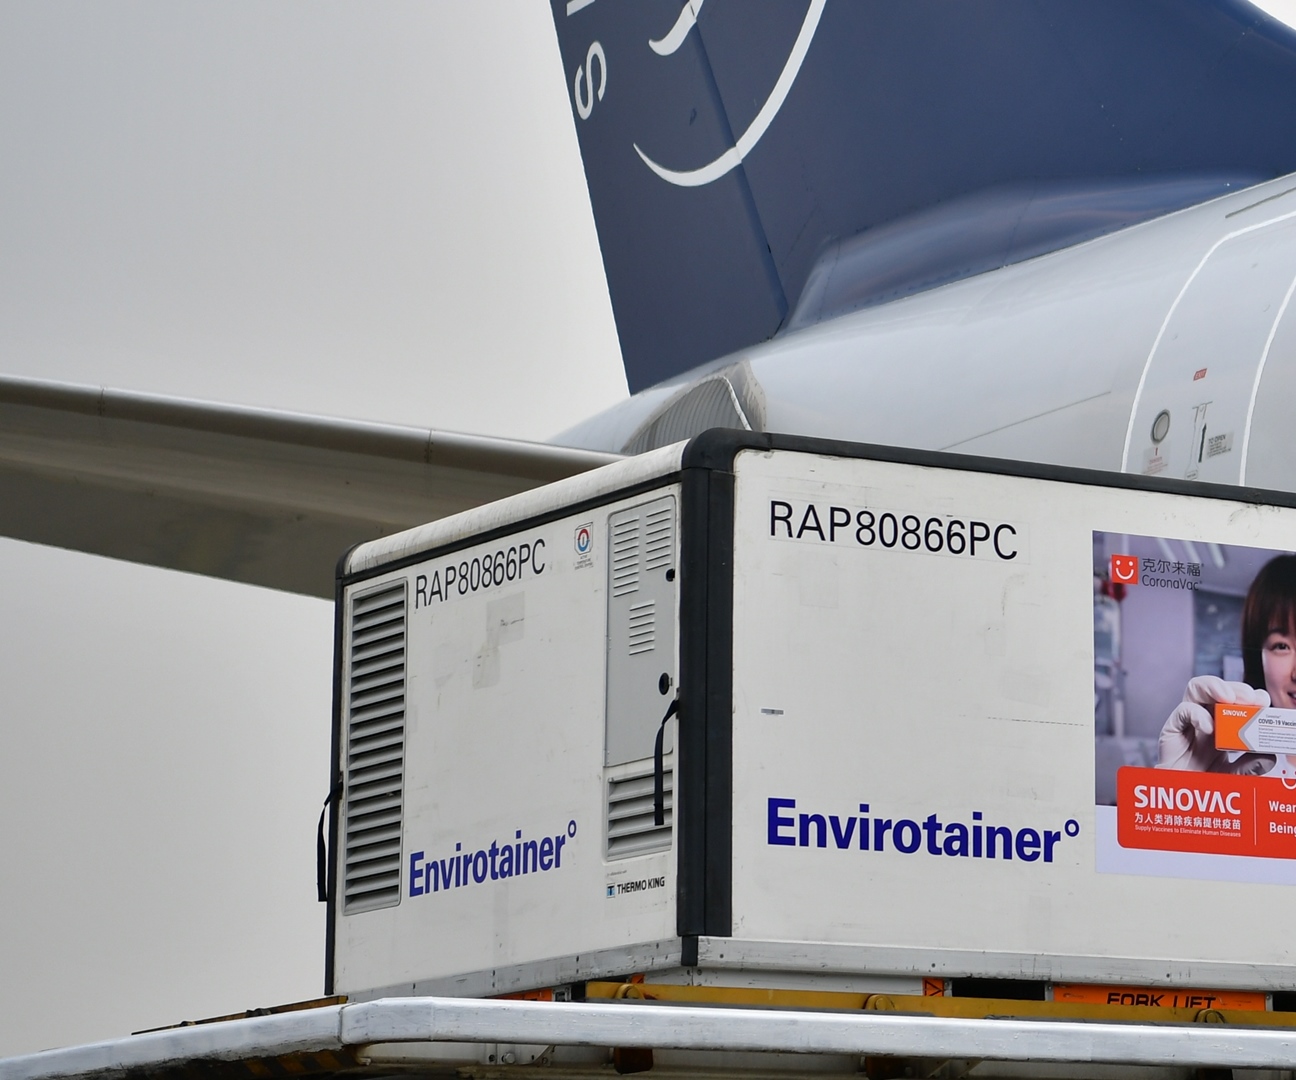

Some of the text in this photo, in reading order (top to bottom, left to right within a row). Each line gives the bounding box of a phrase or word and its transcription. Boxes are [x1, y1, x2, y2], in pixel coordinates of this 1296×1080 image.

[768, 500, 1019, 561] RAP80866PC
[414, 538, 546, 610] RAP80866PC
[1142, 558, 1201, 577] 克尔来福
[1142, 574, 1199, 591] CoronaVac
[1222, 709, 1248, 718] SINOVAC
[1258, 718, 1281, 726] COVID-19
[1133, 784, 1241, 815] SINOVAC
[1134, 812, 1241, 830] 为人类消除疾病提供疫苗
[616, 879, 647, 895] THERMO
[647, 876, 665, 890] KING
